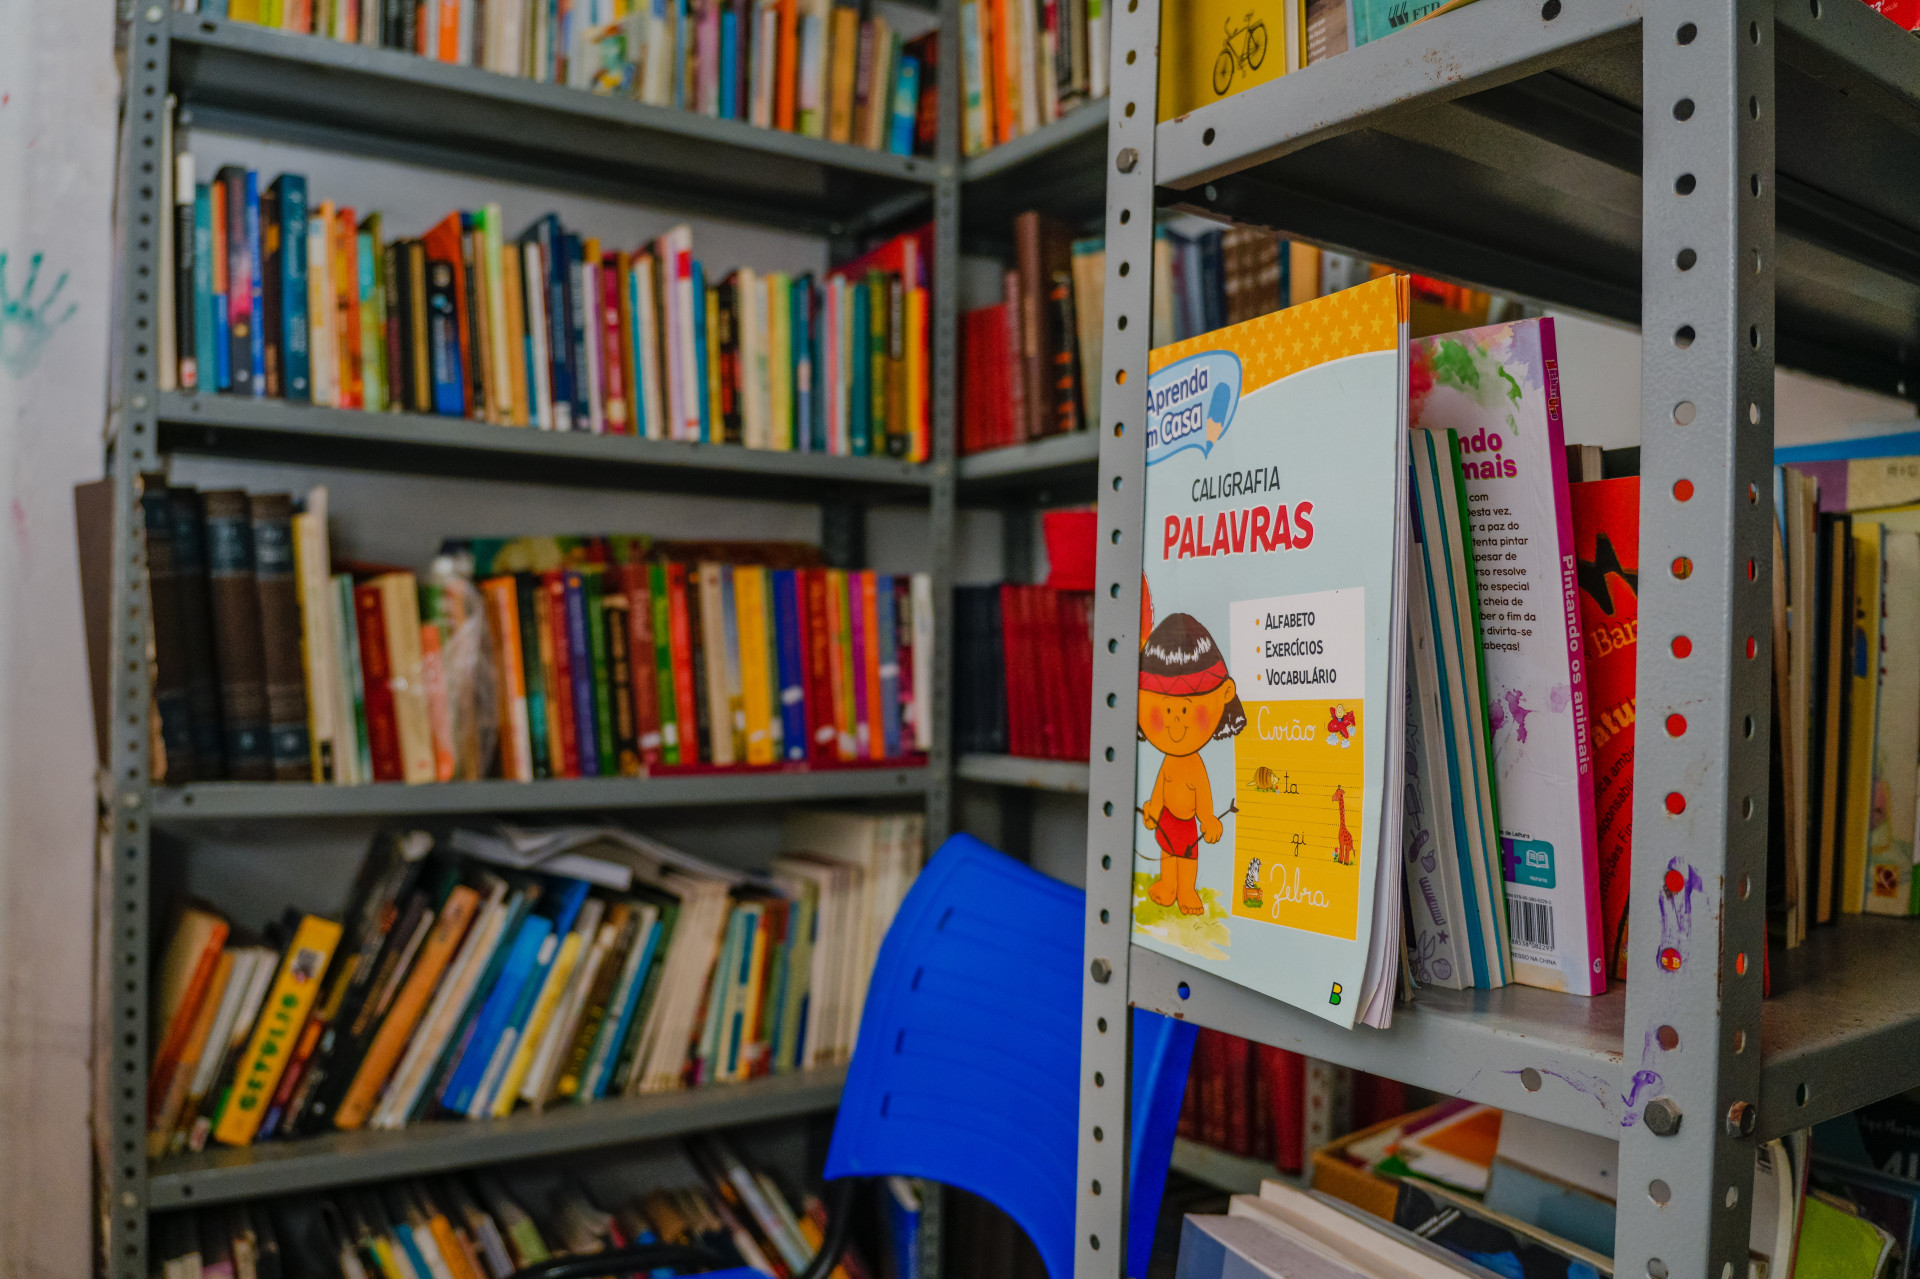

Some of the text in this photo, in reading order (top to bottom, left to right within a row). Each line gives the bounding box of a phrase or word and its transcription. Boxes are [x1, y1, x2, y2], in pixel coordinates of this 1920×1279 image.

[1161, 402, 1203, 445] Casa
[1192, 466, 1281, 502] CALIGRAFIA
[1469, 494, 1489, 502] com
[1163, 501, 1314, 561] PALAVRAS
[1488, 523, 1505, 533] paz
[1507, 521, 1519, 530] do
[1500, 536, 1528, 547] pintar
[1505, 552, 1517, 560] de
[1493, 567, 1527, 576] resolve
[1491, 582, 1530, 592] especial
[1483, 597, 1509, 606] cheia
[1511, 597, 1523, 606] de
[1265, 611, 1315, 631] ALFABETO
[1507, 612, 1522, 621] fim
[1523, 613, 1536, 621] da
[1487, 626, 1533, 636] divirta-se
[1265, 638, 1323, 659] EXERCÍCIOS
[1562, 554, 1590, 775] Pintando os animais
[1266, 667, 1337, 686] VOCABULÁRIO
[1284, 771, 1300, 795] ta
[1270, 863, 1330, 919] Zebra
[1539, 957, 1557, 966] CHINA
